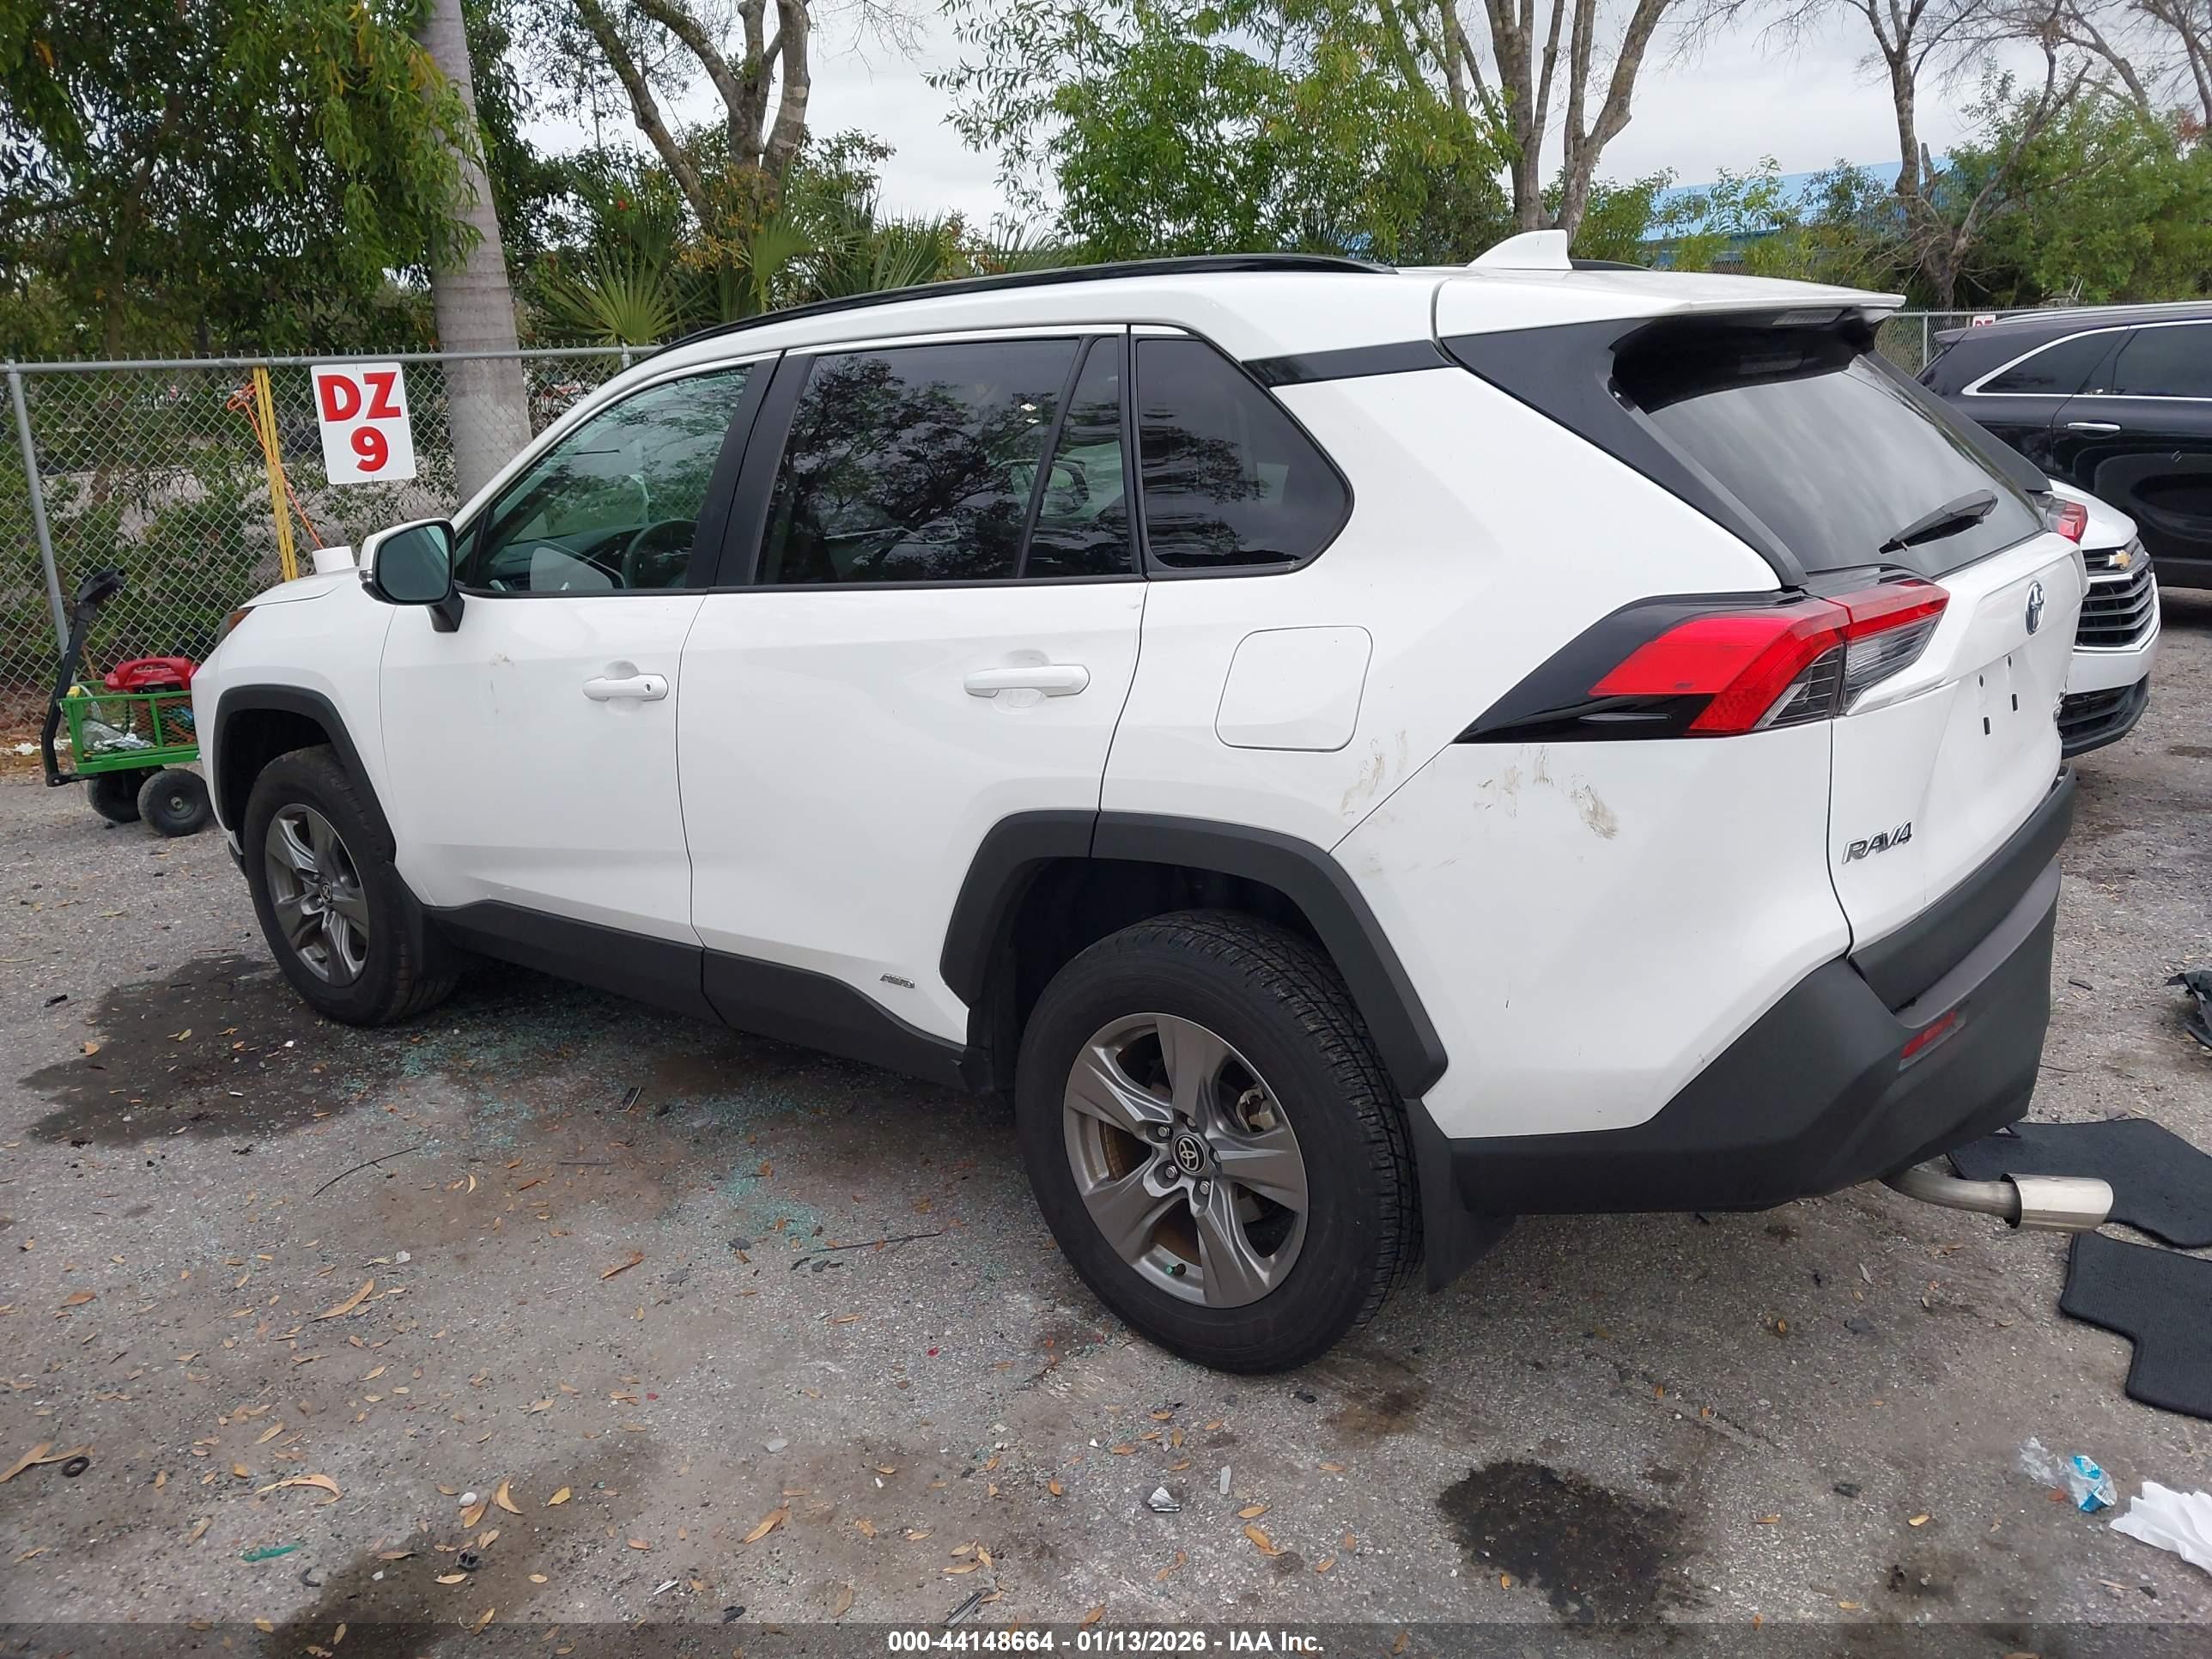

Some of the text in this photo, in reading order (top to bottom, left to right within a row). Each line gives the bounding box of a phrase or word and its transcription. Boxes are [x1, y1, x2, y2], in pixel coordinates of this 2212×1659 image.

[316, 371, 403, 422] DZ
[350, 425, 389, 472] 9
[1841, 818, 1914, 865] RAV4
